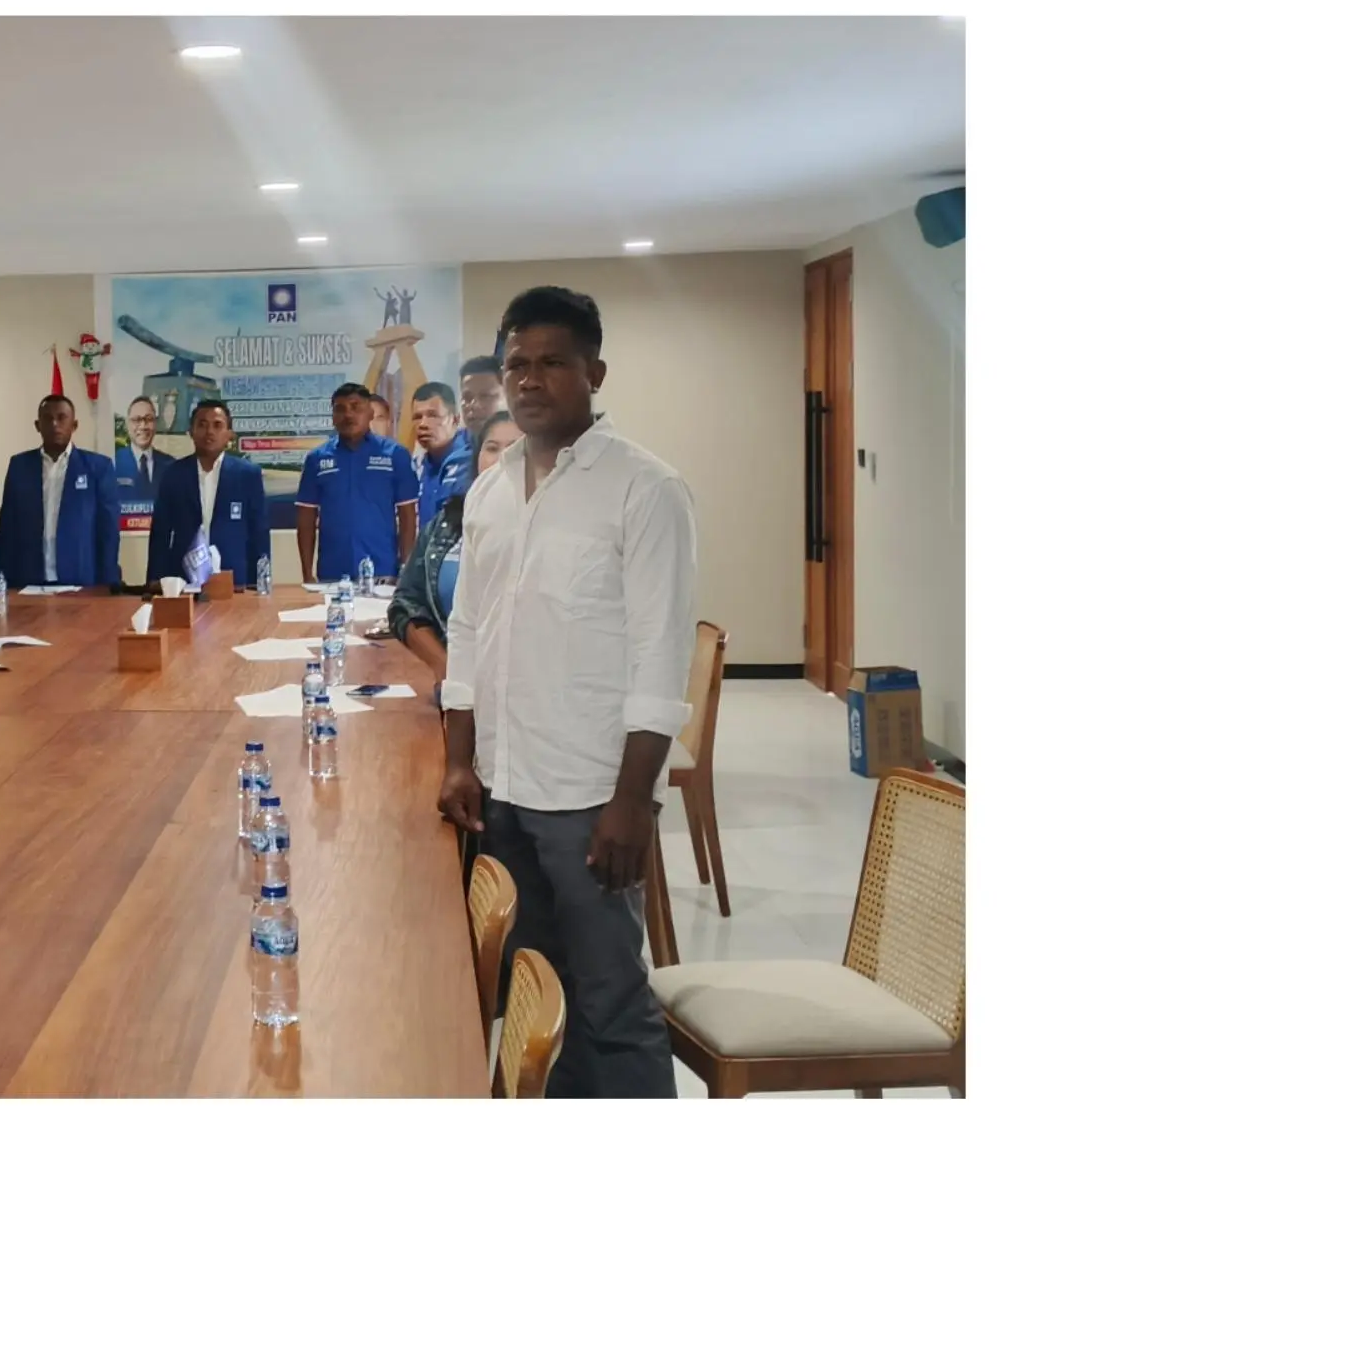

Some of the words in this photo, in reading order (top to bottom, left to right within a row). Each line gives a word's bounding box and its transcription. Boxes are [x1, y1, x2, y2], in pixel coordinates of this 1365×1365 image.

[268, 310, 297, 324] PAN
[214, 335, 281, 369] SELAMAT
[284, 337, 294, 366] &
[297, 333, 353, 366] SUKSES
